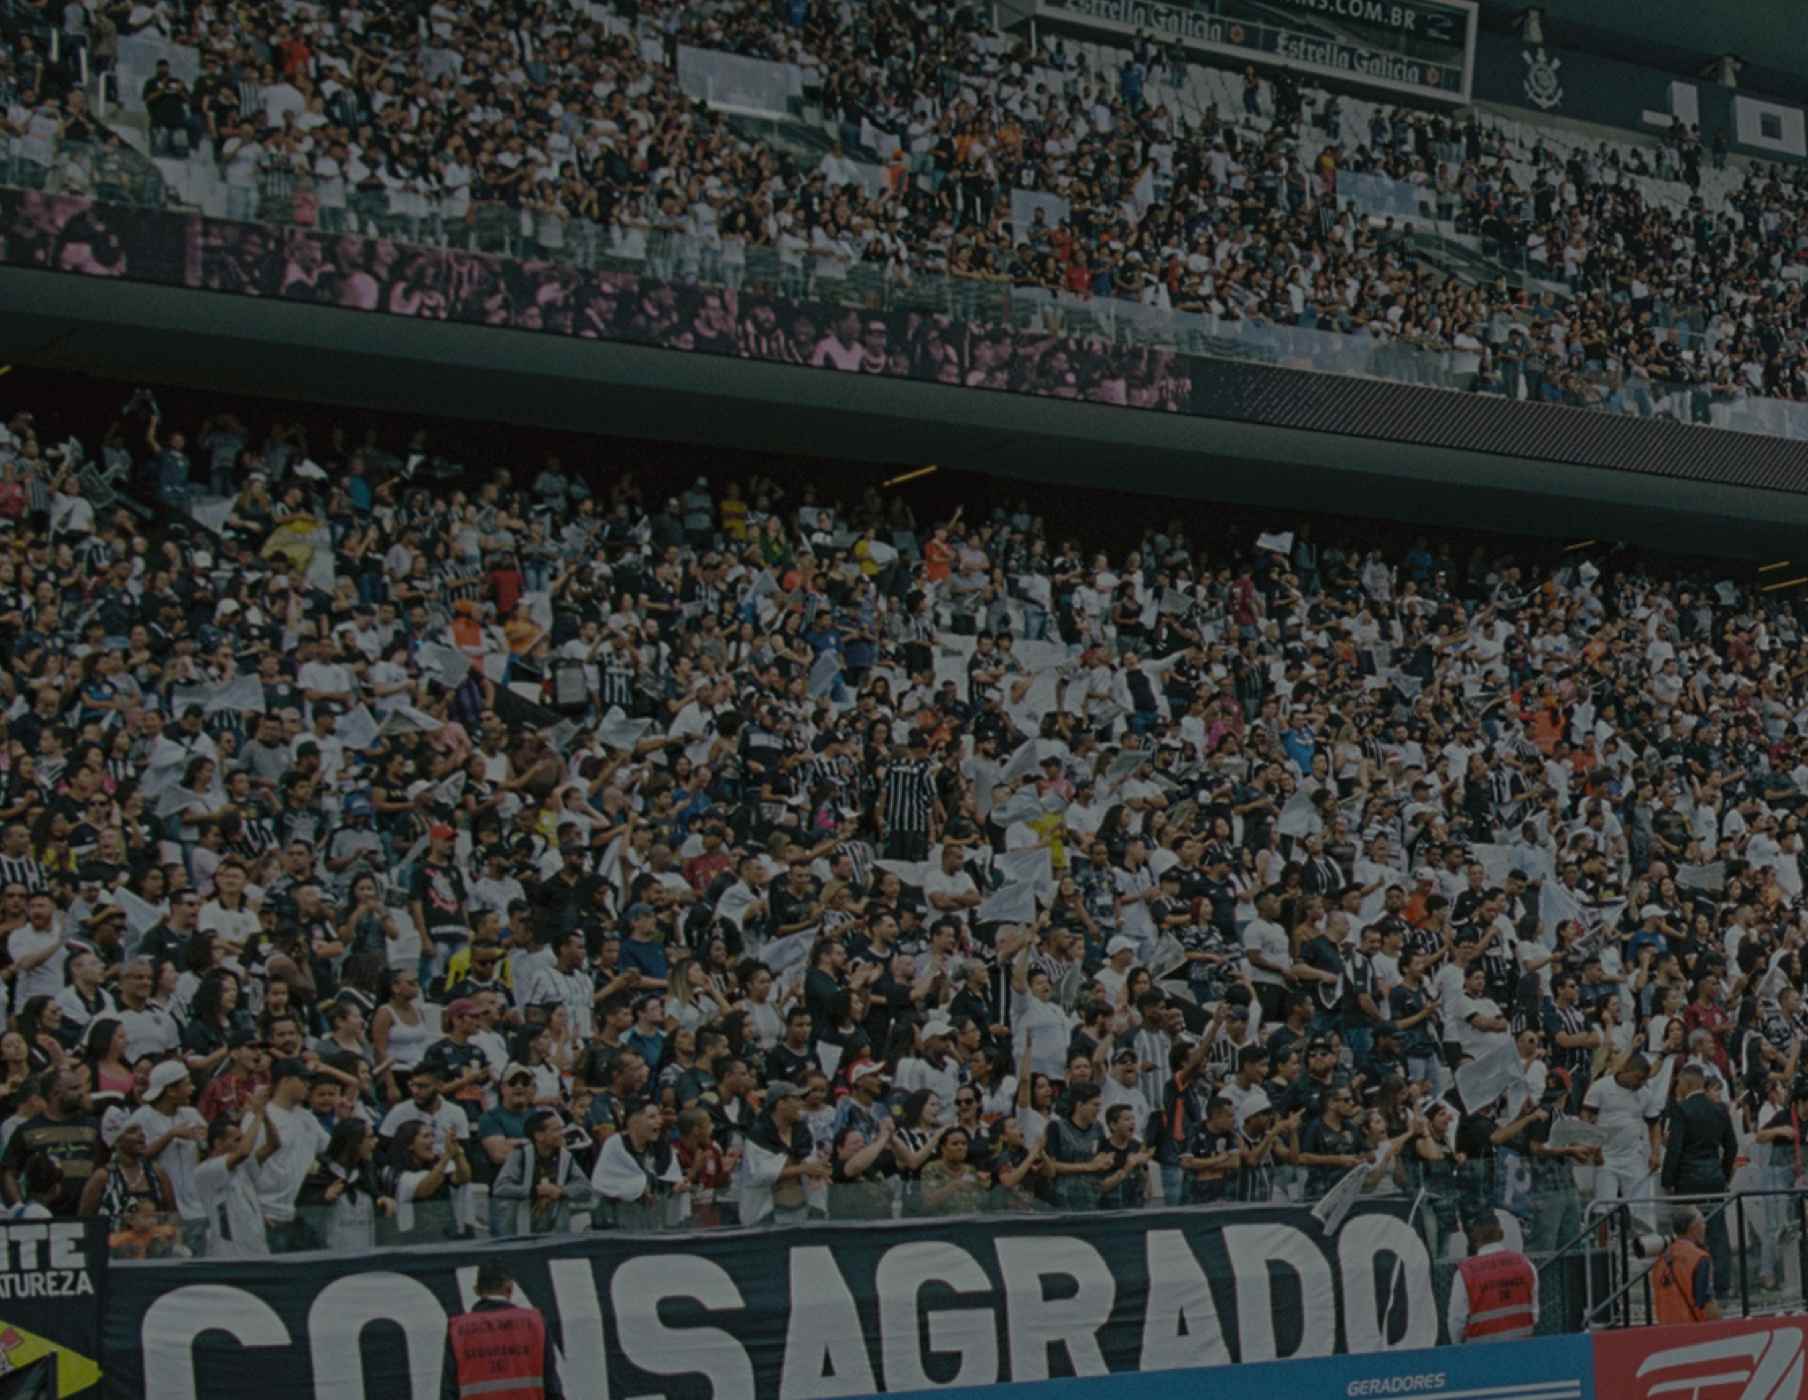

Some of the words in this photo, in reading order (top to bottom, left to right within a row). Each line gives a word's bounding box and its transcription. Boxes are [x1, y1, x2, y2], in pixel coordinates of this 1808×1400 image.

[1151, 3, 1222, 41] Galicia
[1277, 28, 1350, 70] Estrella
[1353, 49, 1420, 84] Galicia
[141, 1212, 1440, 1400] CONSAGRADO
[1347, 1371, 1448, 1397] GERADORES
